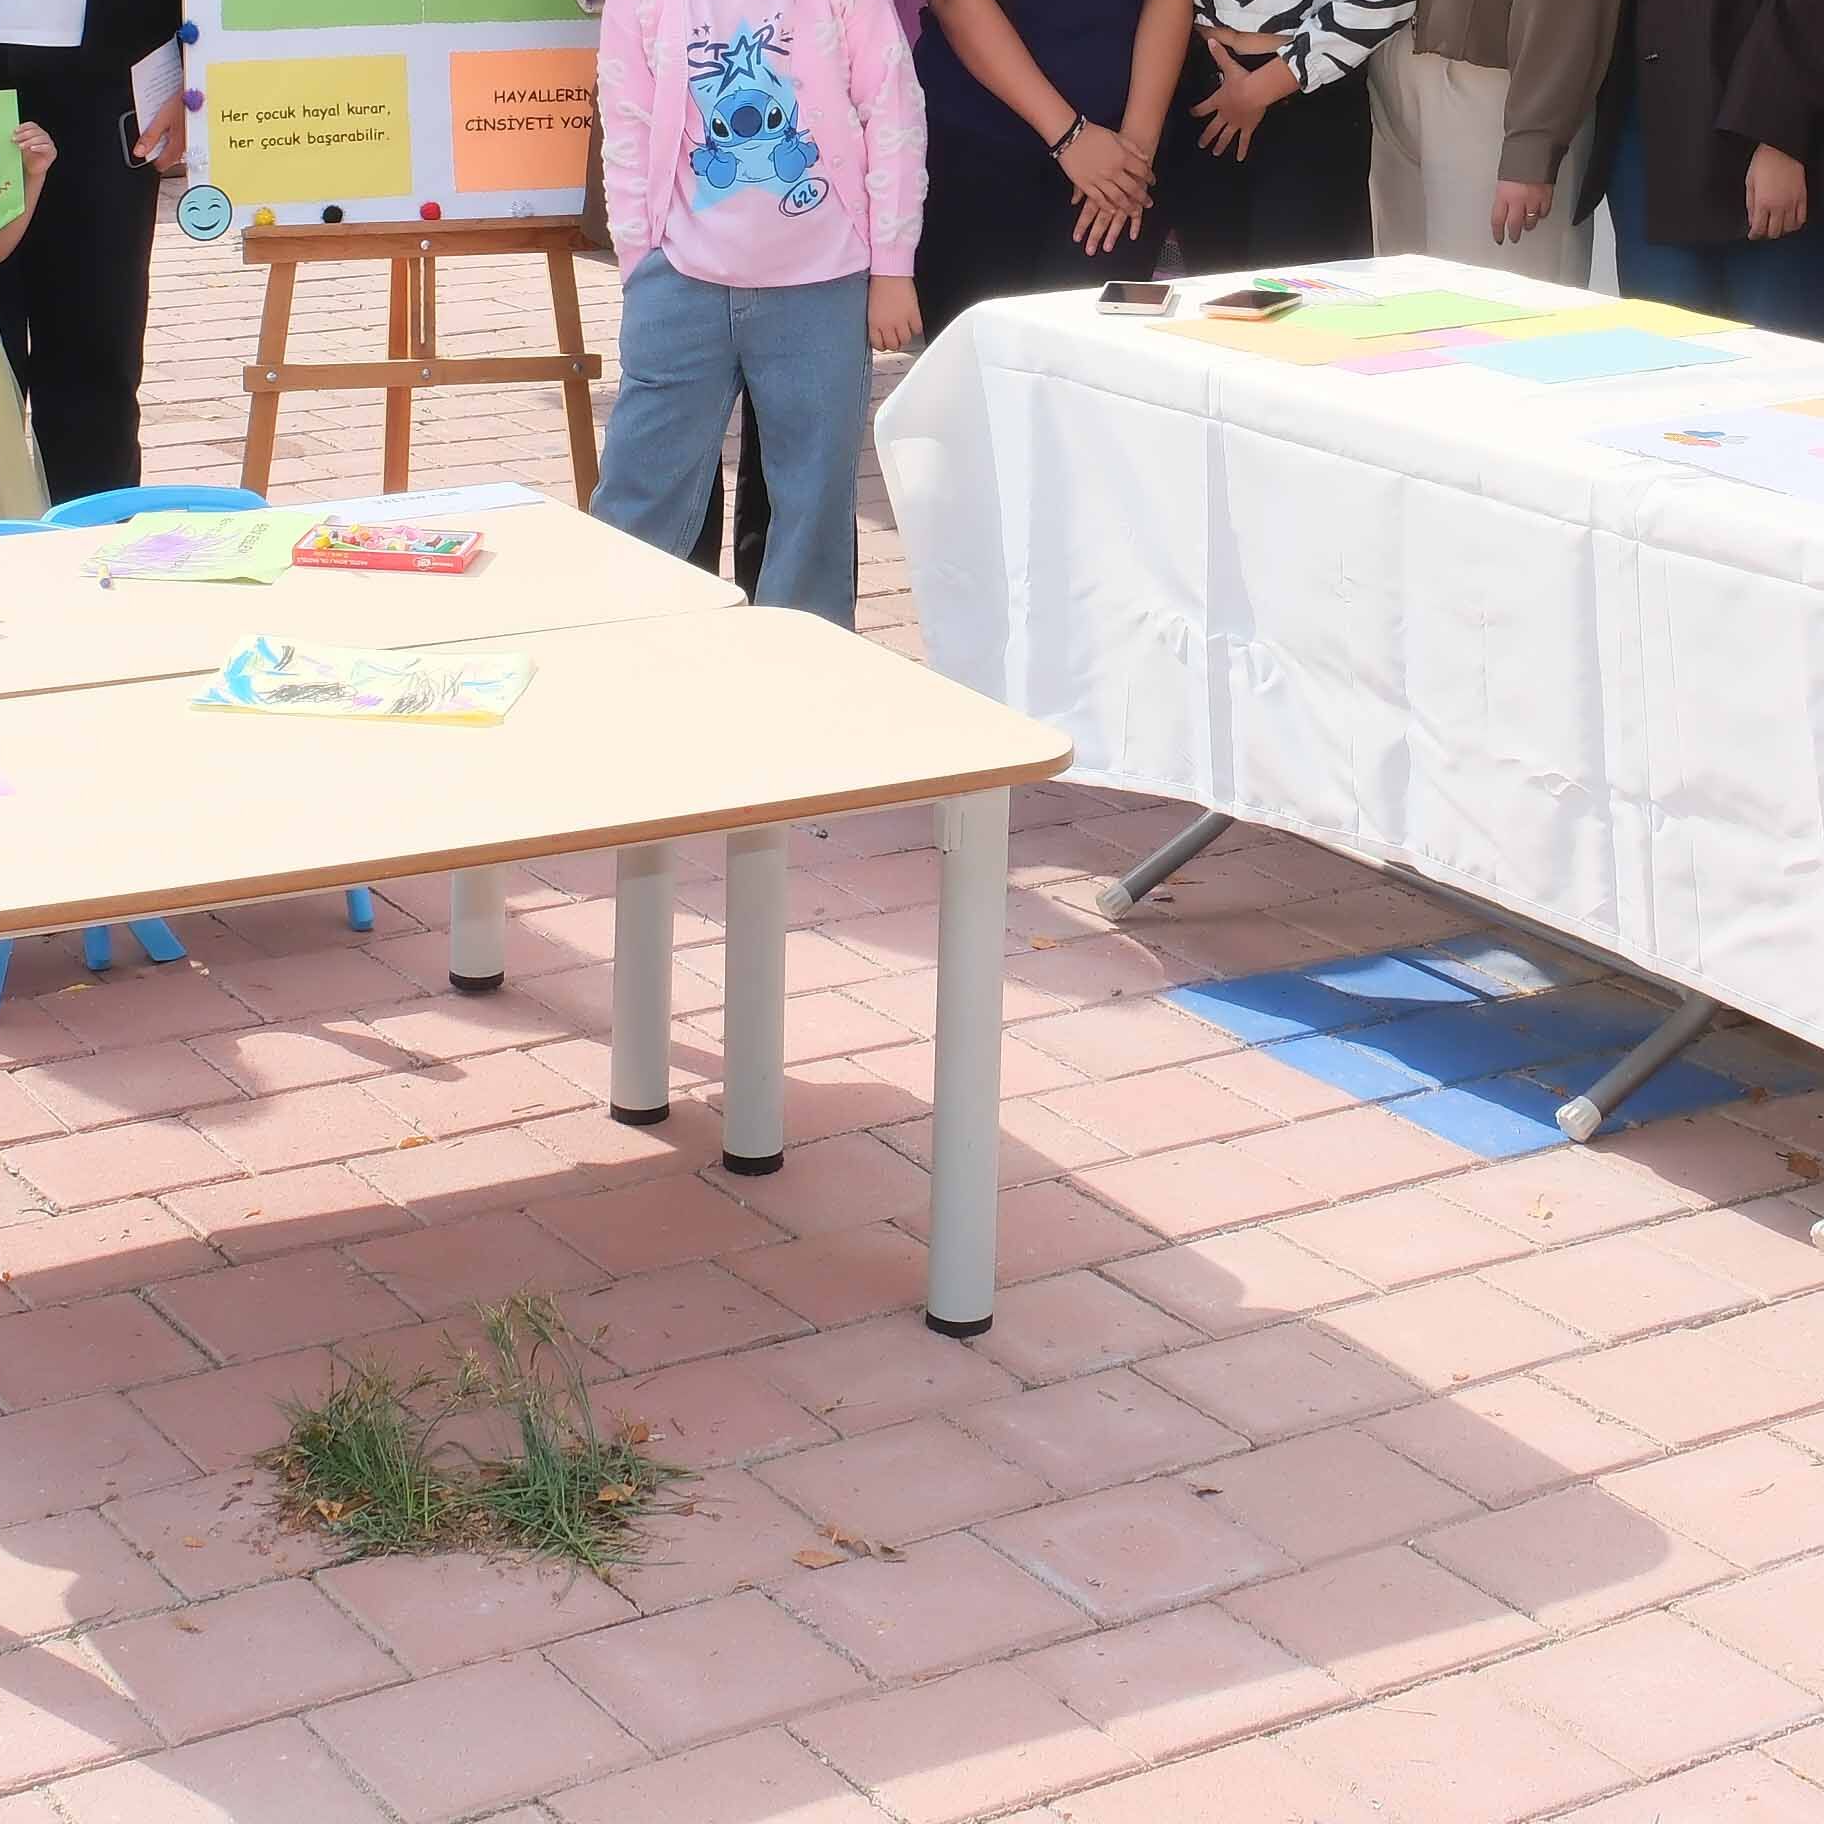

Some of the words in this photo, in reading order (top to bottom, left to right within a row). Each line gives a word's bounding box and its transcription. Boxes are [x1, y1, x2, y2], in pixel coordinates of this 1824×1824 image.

[221, 109, 249, 123] Her
[255, 106, 296, 123] çocuk
[303, 103, 340, 120] hayal
[347, 101, 392, 116] kurar,
[465, 114, 554, 132] CİNSİYETİ
[229, 135, 254, 149] her
[260, 132, 301, 150] çocuk
[792, 183, 818, 209] 626
